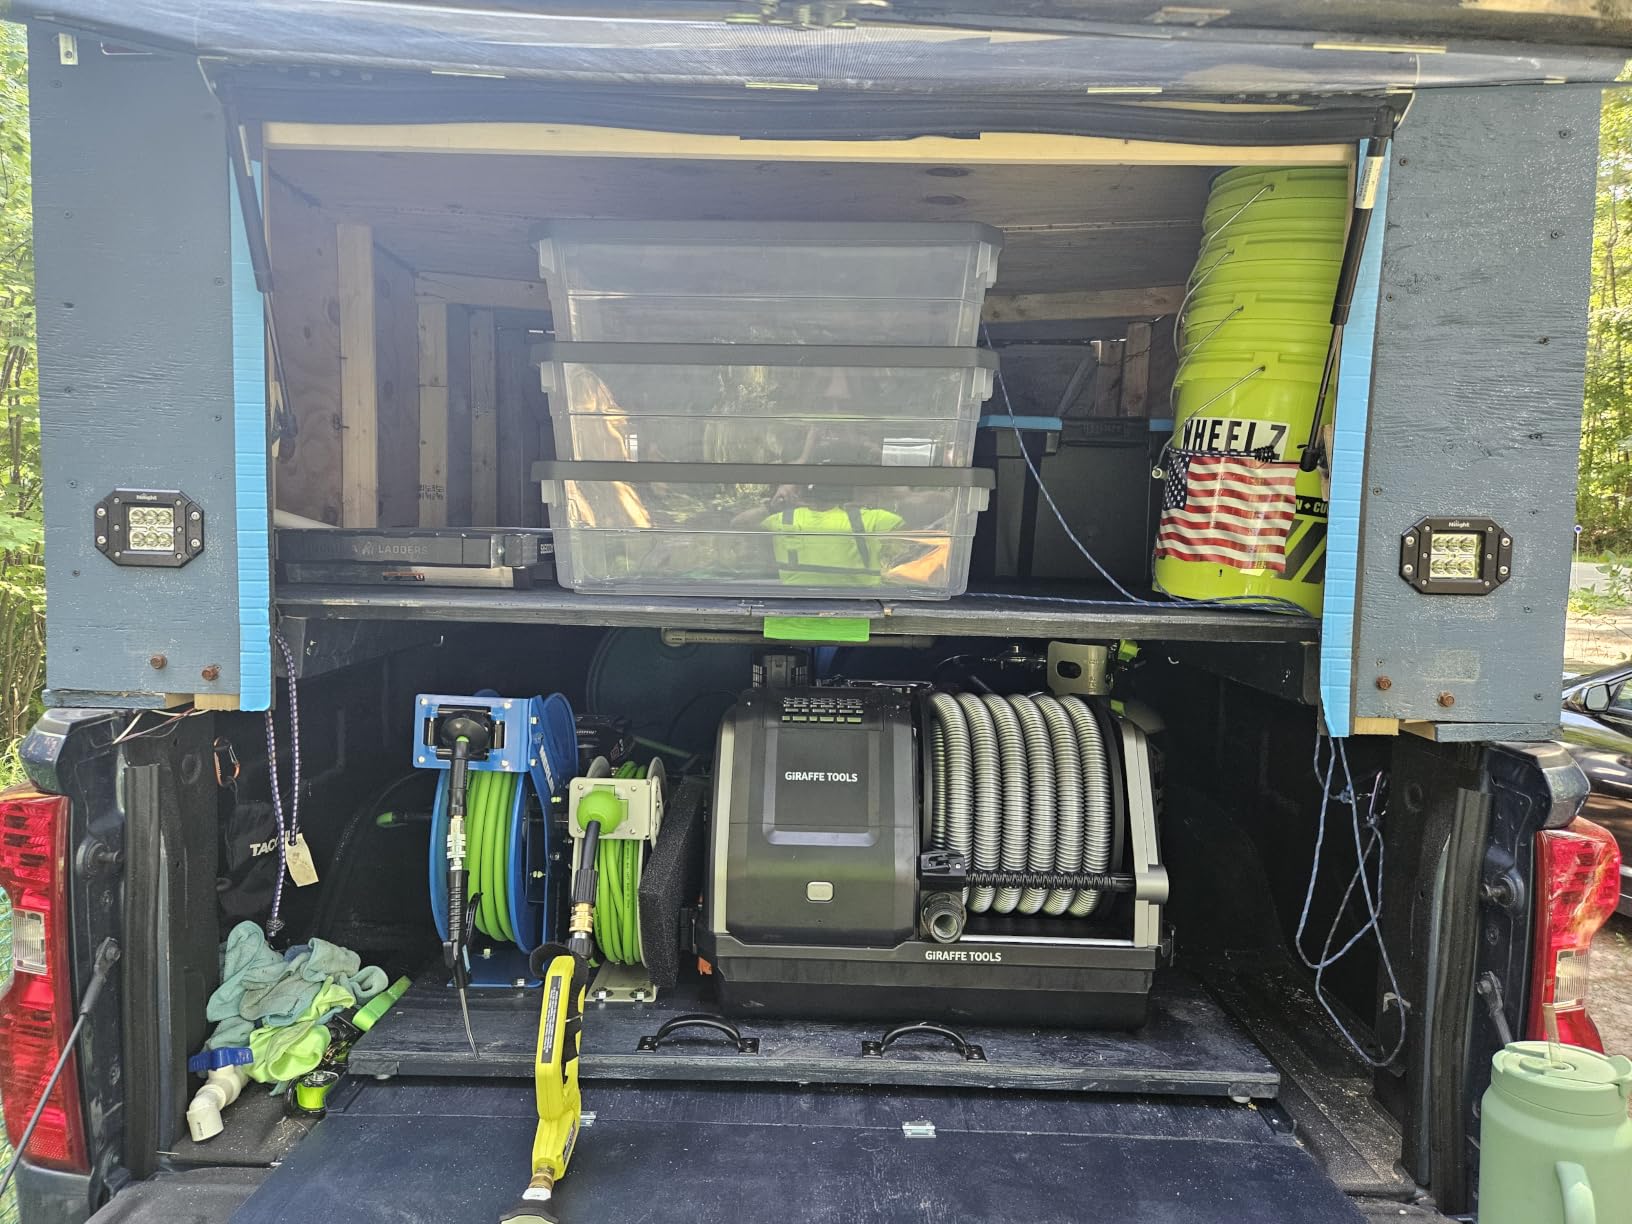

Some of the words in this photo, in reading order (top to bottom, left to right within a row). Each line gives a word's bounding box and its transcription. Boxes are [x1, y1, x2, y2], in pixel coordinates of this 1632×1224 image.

[1313, 501, 1329, 514] CU
[378, 543, 428, 554] LADDERS
[826, 772, 858, 783] TOOLS
[968, 951, 1002, 962] TOOLS
